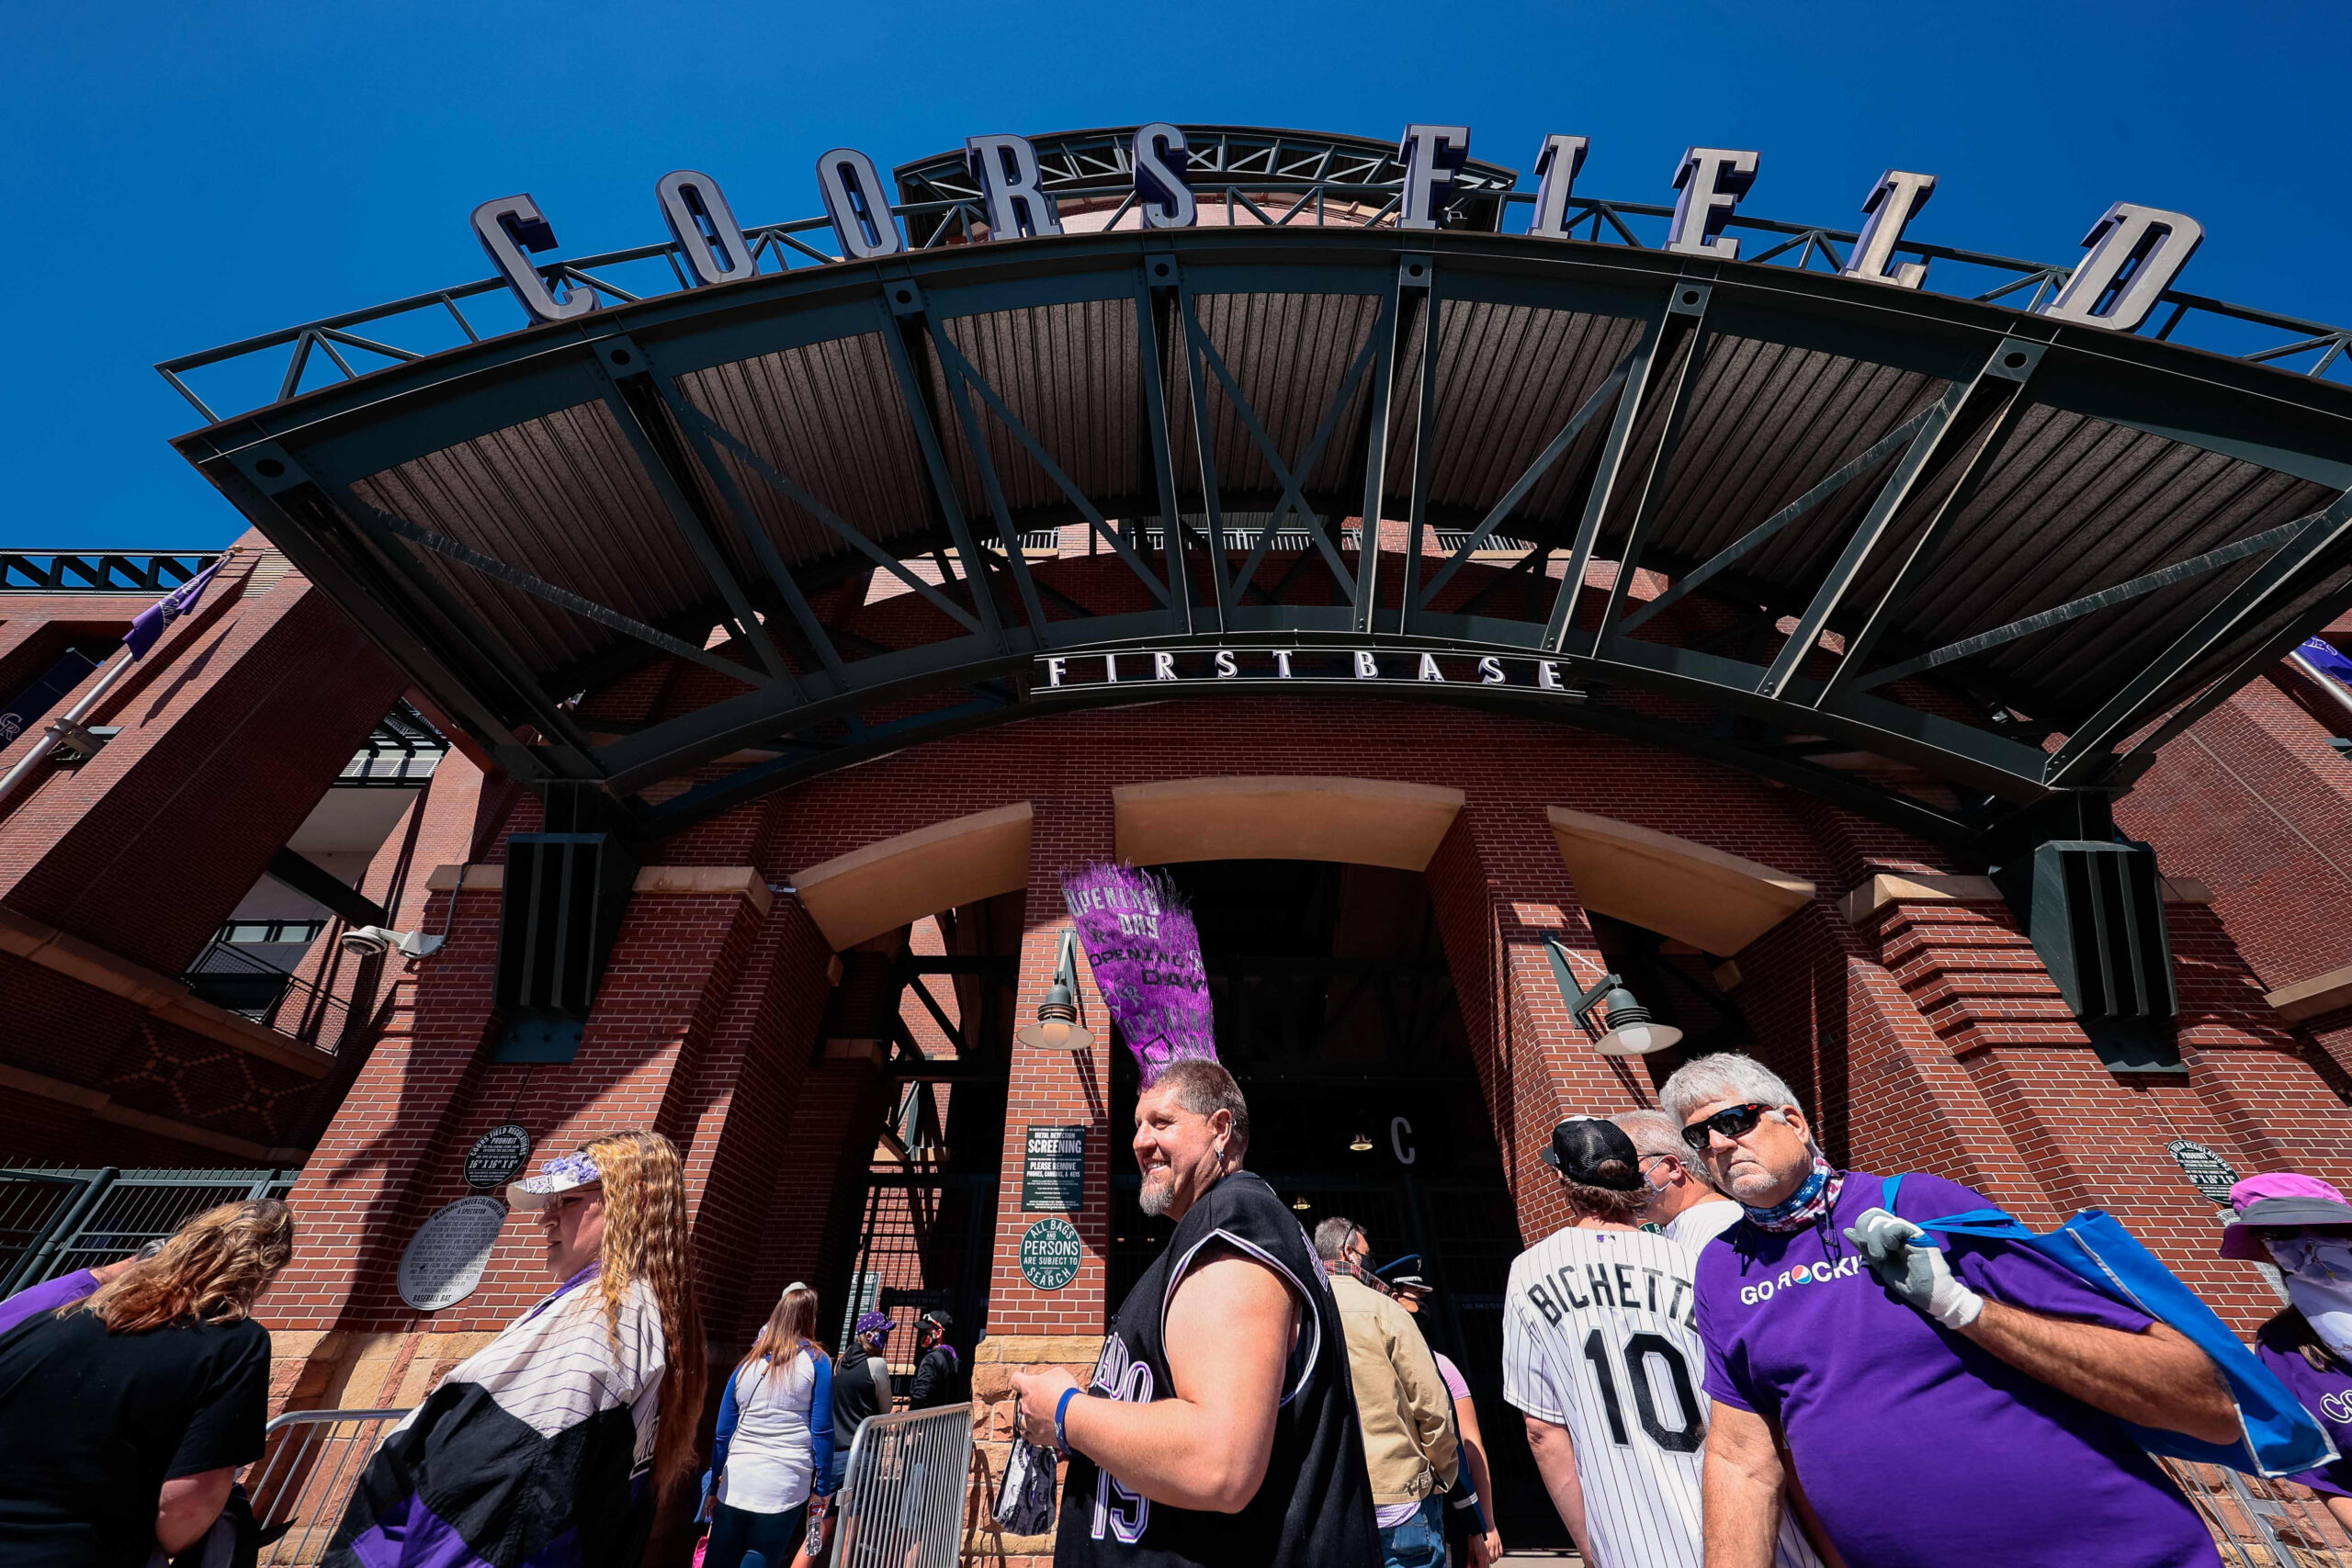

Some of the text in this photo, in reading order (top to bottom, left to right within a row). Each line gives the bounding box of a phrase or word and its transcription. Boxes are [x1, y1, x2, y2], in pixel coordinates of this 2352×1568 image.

[469, 122, 2205, 333] COORS FIELD
[1047, 649, 1566, 690] FIRST BASE
[1064, 886, 1161, 918] OPENING
[1117, 913, 1159, 939] DAY
[1088, 949, 1185, 968] OPENING
[1141, 968, 1204, 994] DAY
[469, 1135, 490, 1156] COORS
[490, 1127, 507, 1139] FIELD
[1027, 1139, 1081, 1154] SCREENING
[1390, 1116, 1416, 1165] C
[1030, 1161, 1076, 1170] PLEASE REMOVE
[1030, 1219, 1075, 1239] ALL BAGS
[1023, 1240, 1079, 1256] PERSONS
[1023, 1257, 1078, 1265] ARE SUBJECT TO
[1026, 1267, 1071, 1286] SEARCH
[412, 1294, 439, 1303] BASEBALL
[1740, 1280, 1774, 1305] GO
[1582, 1327, 1707, 1456] 10
